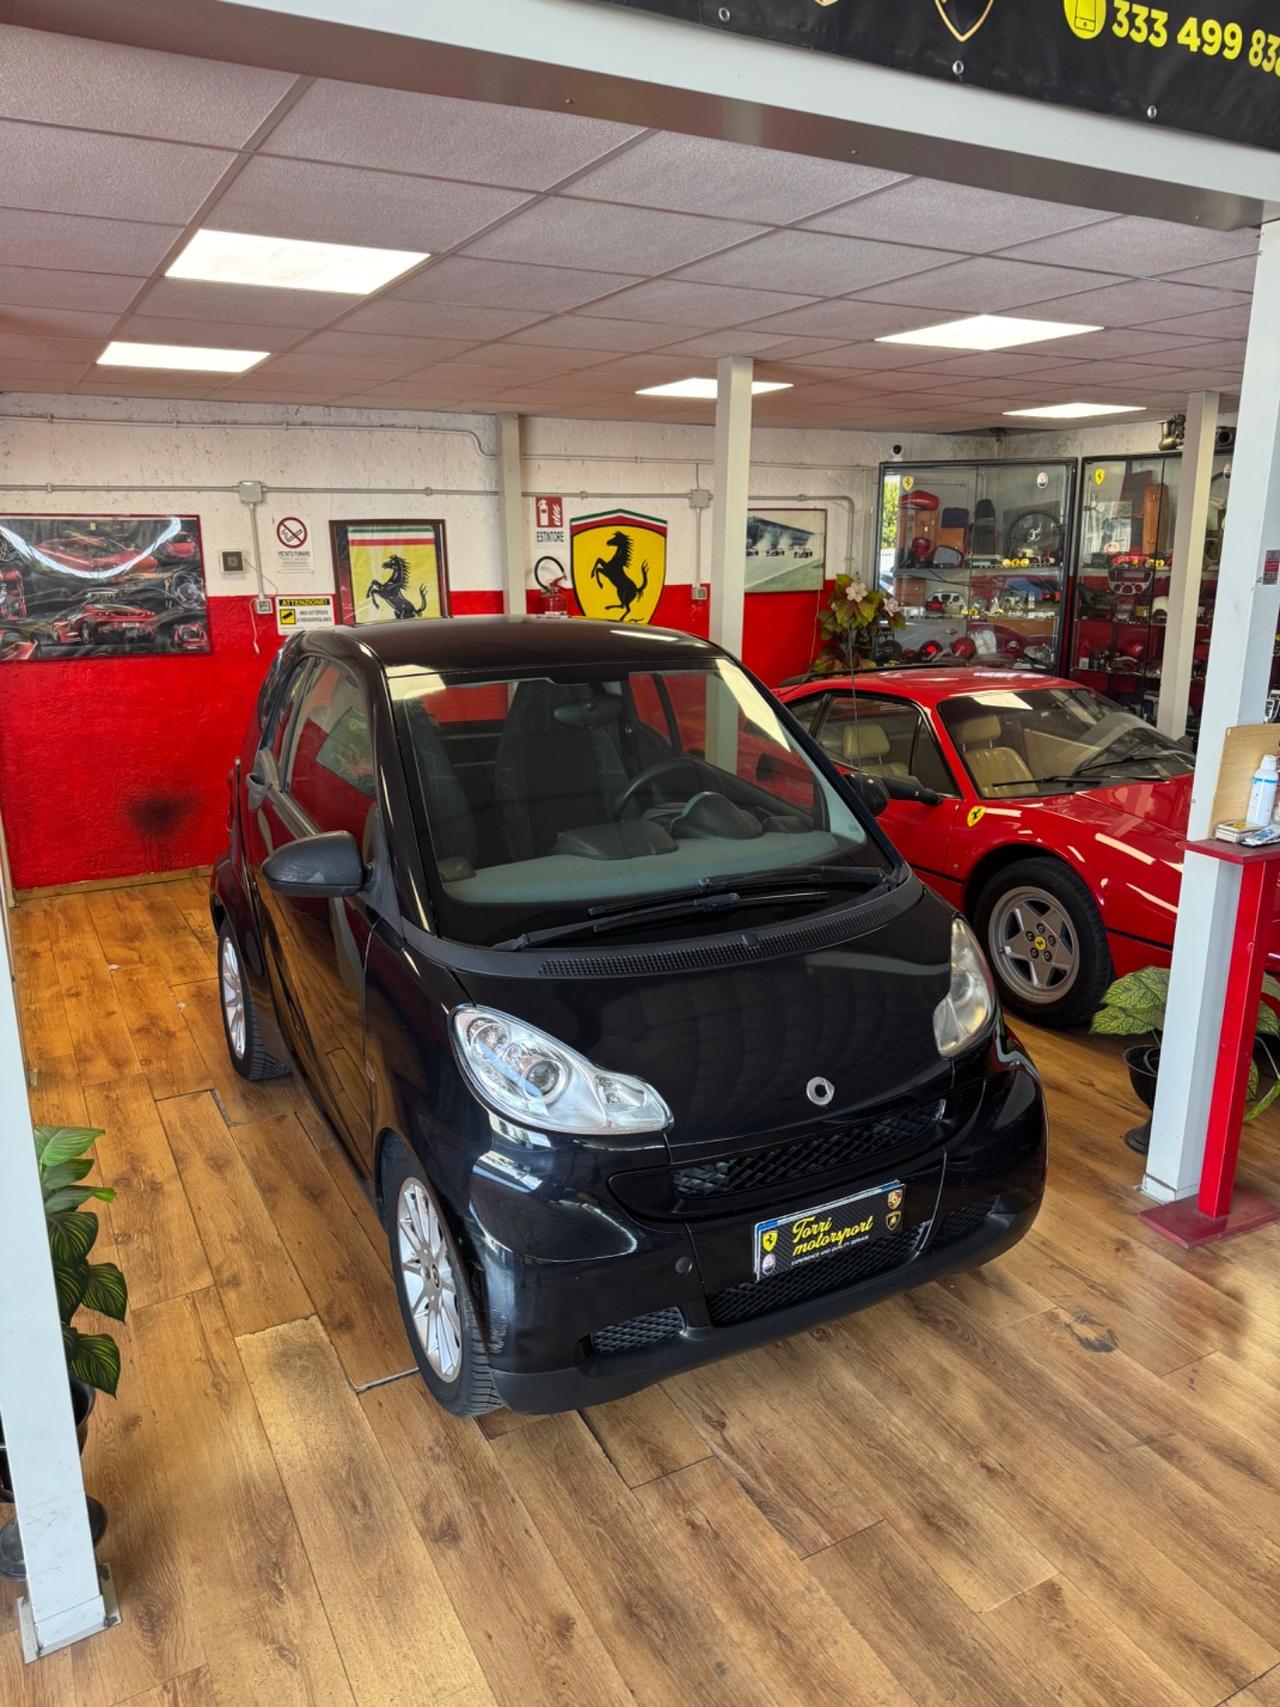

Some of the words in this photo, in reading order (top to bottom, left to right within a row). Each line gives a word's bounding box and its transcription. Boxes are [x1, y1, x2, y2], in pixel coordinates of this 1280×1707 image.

[1112, 0, 1169, 48] 333
[1176, 17, 1243, 60] 499
[792, 1216, 832, 1243] Torri
[792, 1215, 874, 1256] motorsport
